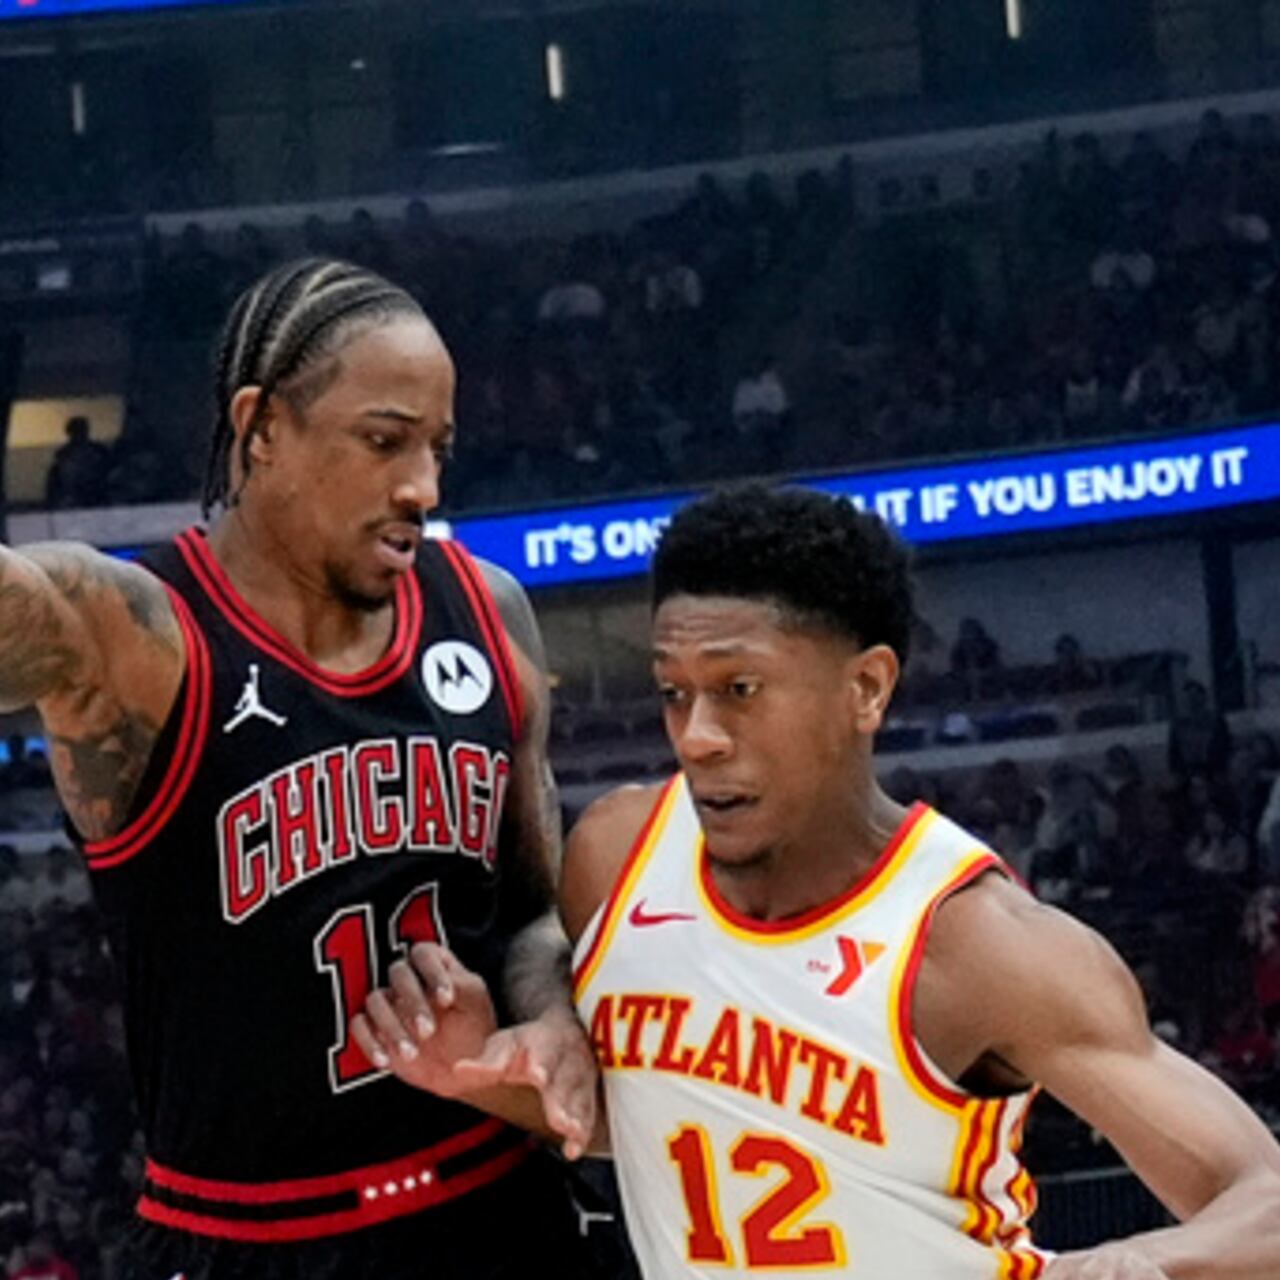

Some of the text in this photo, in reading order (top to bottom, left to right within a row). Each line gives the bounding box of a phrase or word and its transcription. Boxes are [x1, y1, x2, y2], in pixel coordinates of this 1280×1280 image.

[524, 523, 598, 568] IT'S
[920, 484, 958, 523] IF
[967, 472, 1057, 517] YOU
[1066, 455, 1202, 507] ENJOY
[1210, 447, 1248, 488] IT
[590, 991, 888, 1148] ATLANTA
[665, 1121, 848, 1270] 12
